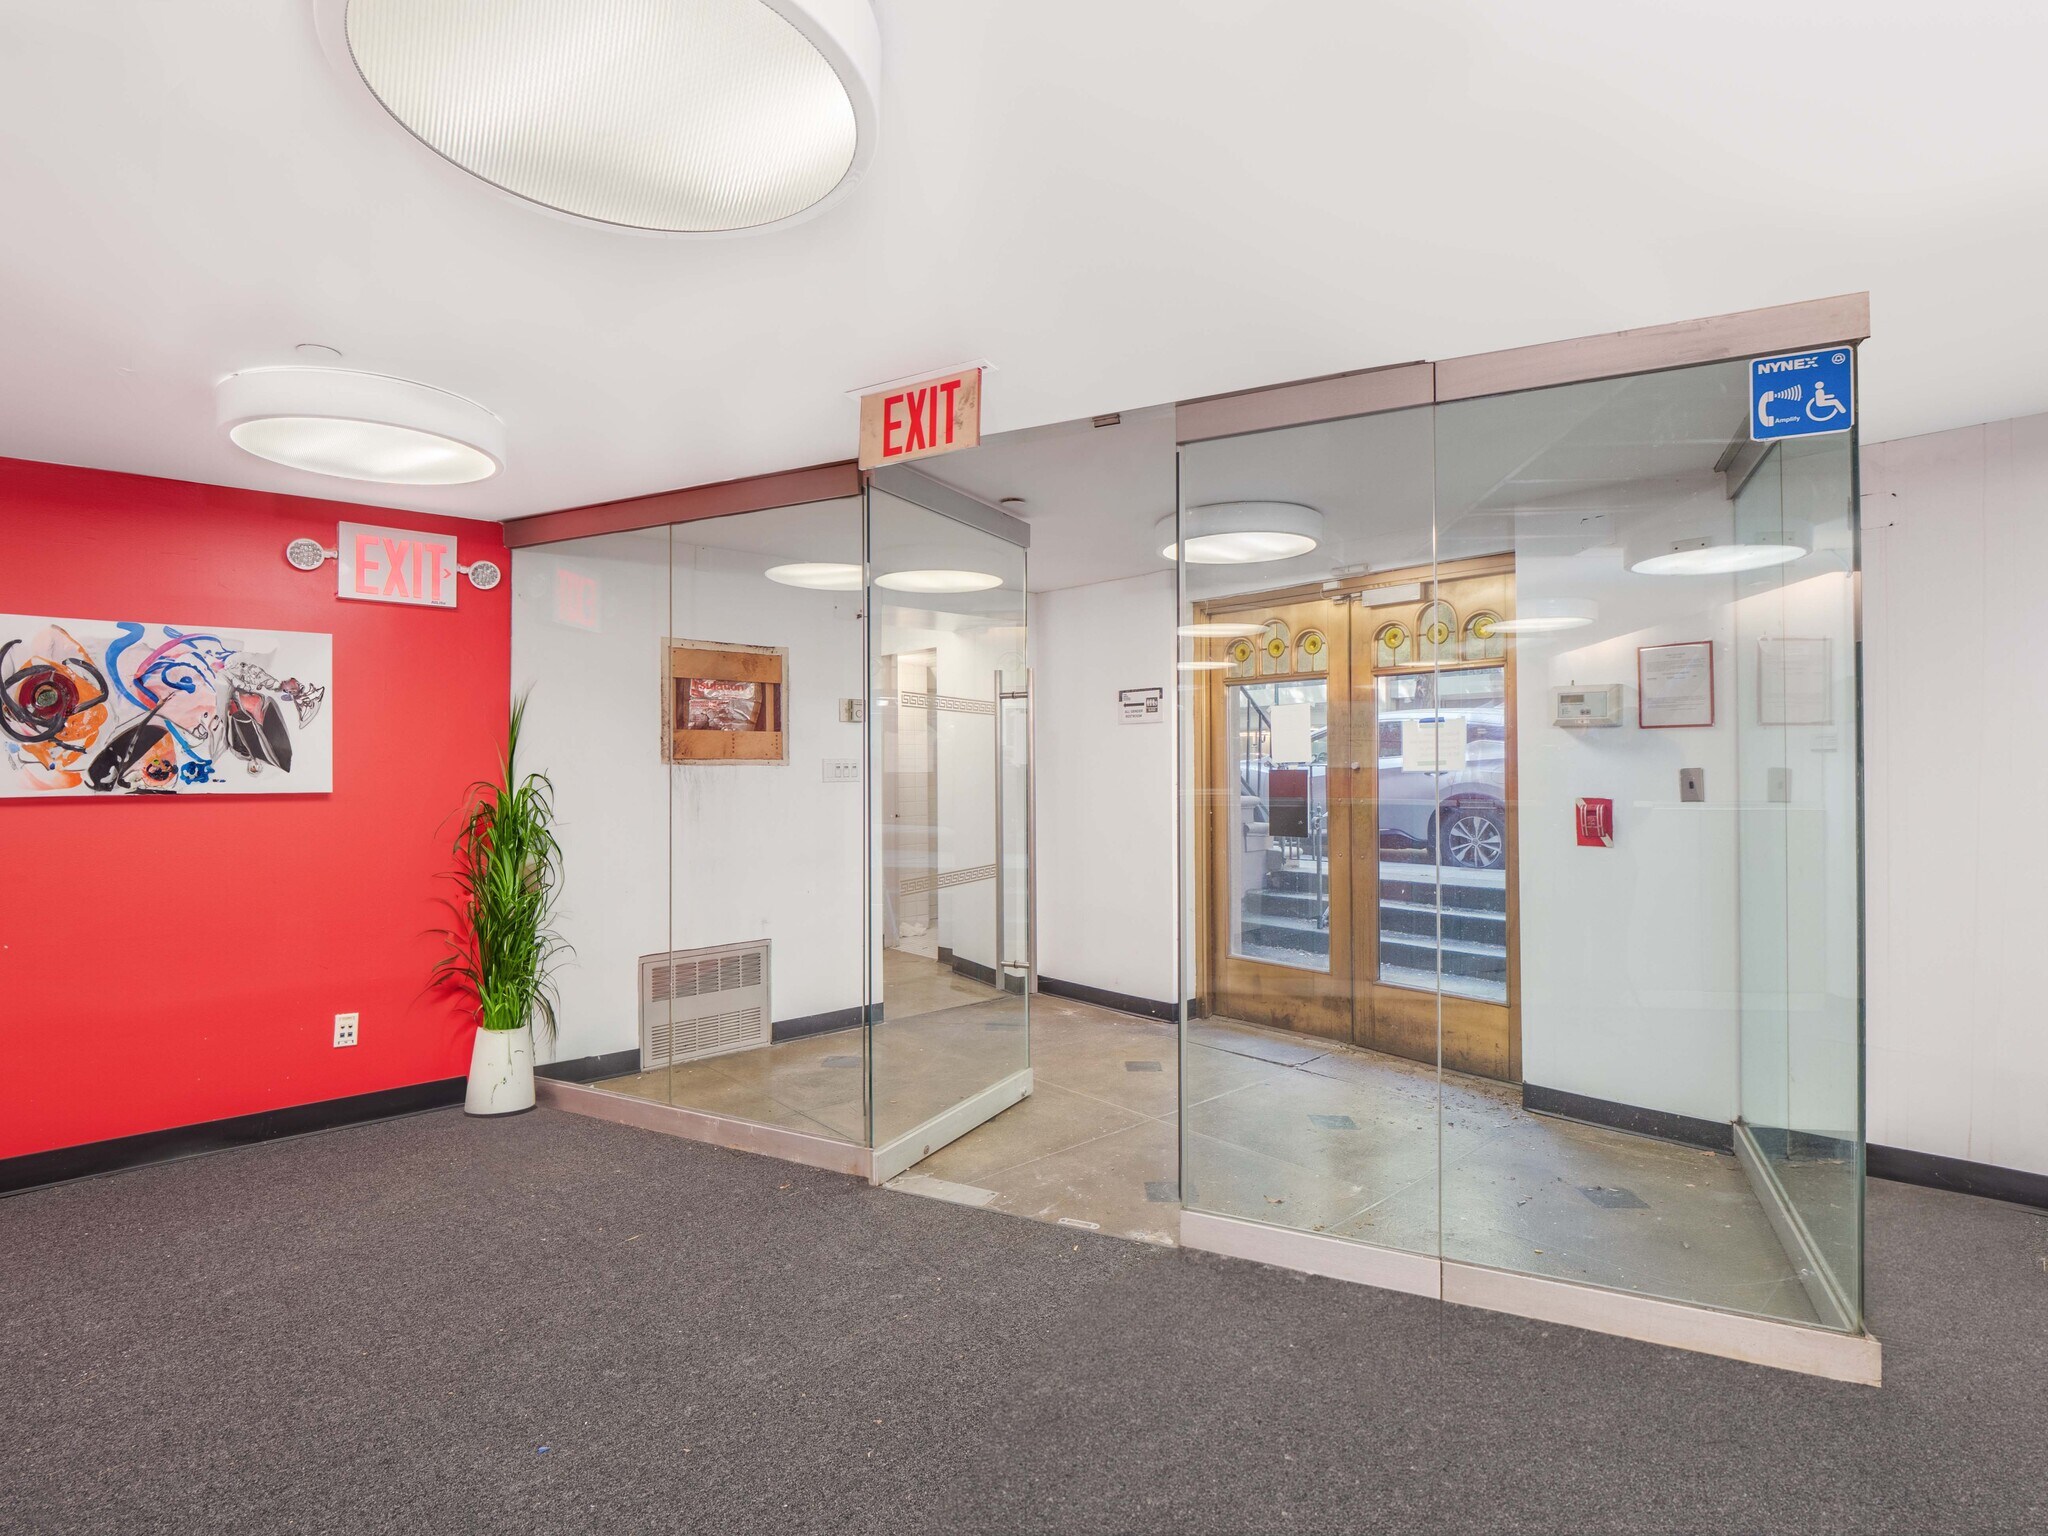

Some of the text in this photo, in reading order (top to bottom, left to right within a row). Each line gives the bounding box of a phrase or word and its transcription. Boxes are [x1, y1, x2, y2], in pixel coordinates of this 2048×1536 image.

[1758, 356, 1819, 374] NYNEX
[883, 379, 961, 457] EXIT
[1775, 416, 1801, 424] Amplify
[355, 534, 447, 601] EXIT
